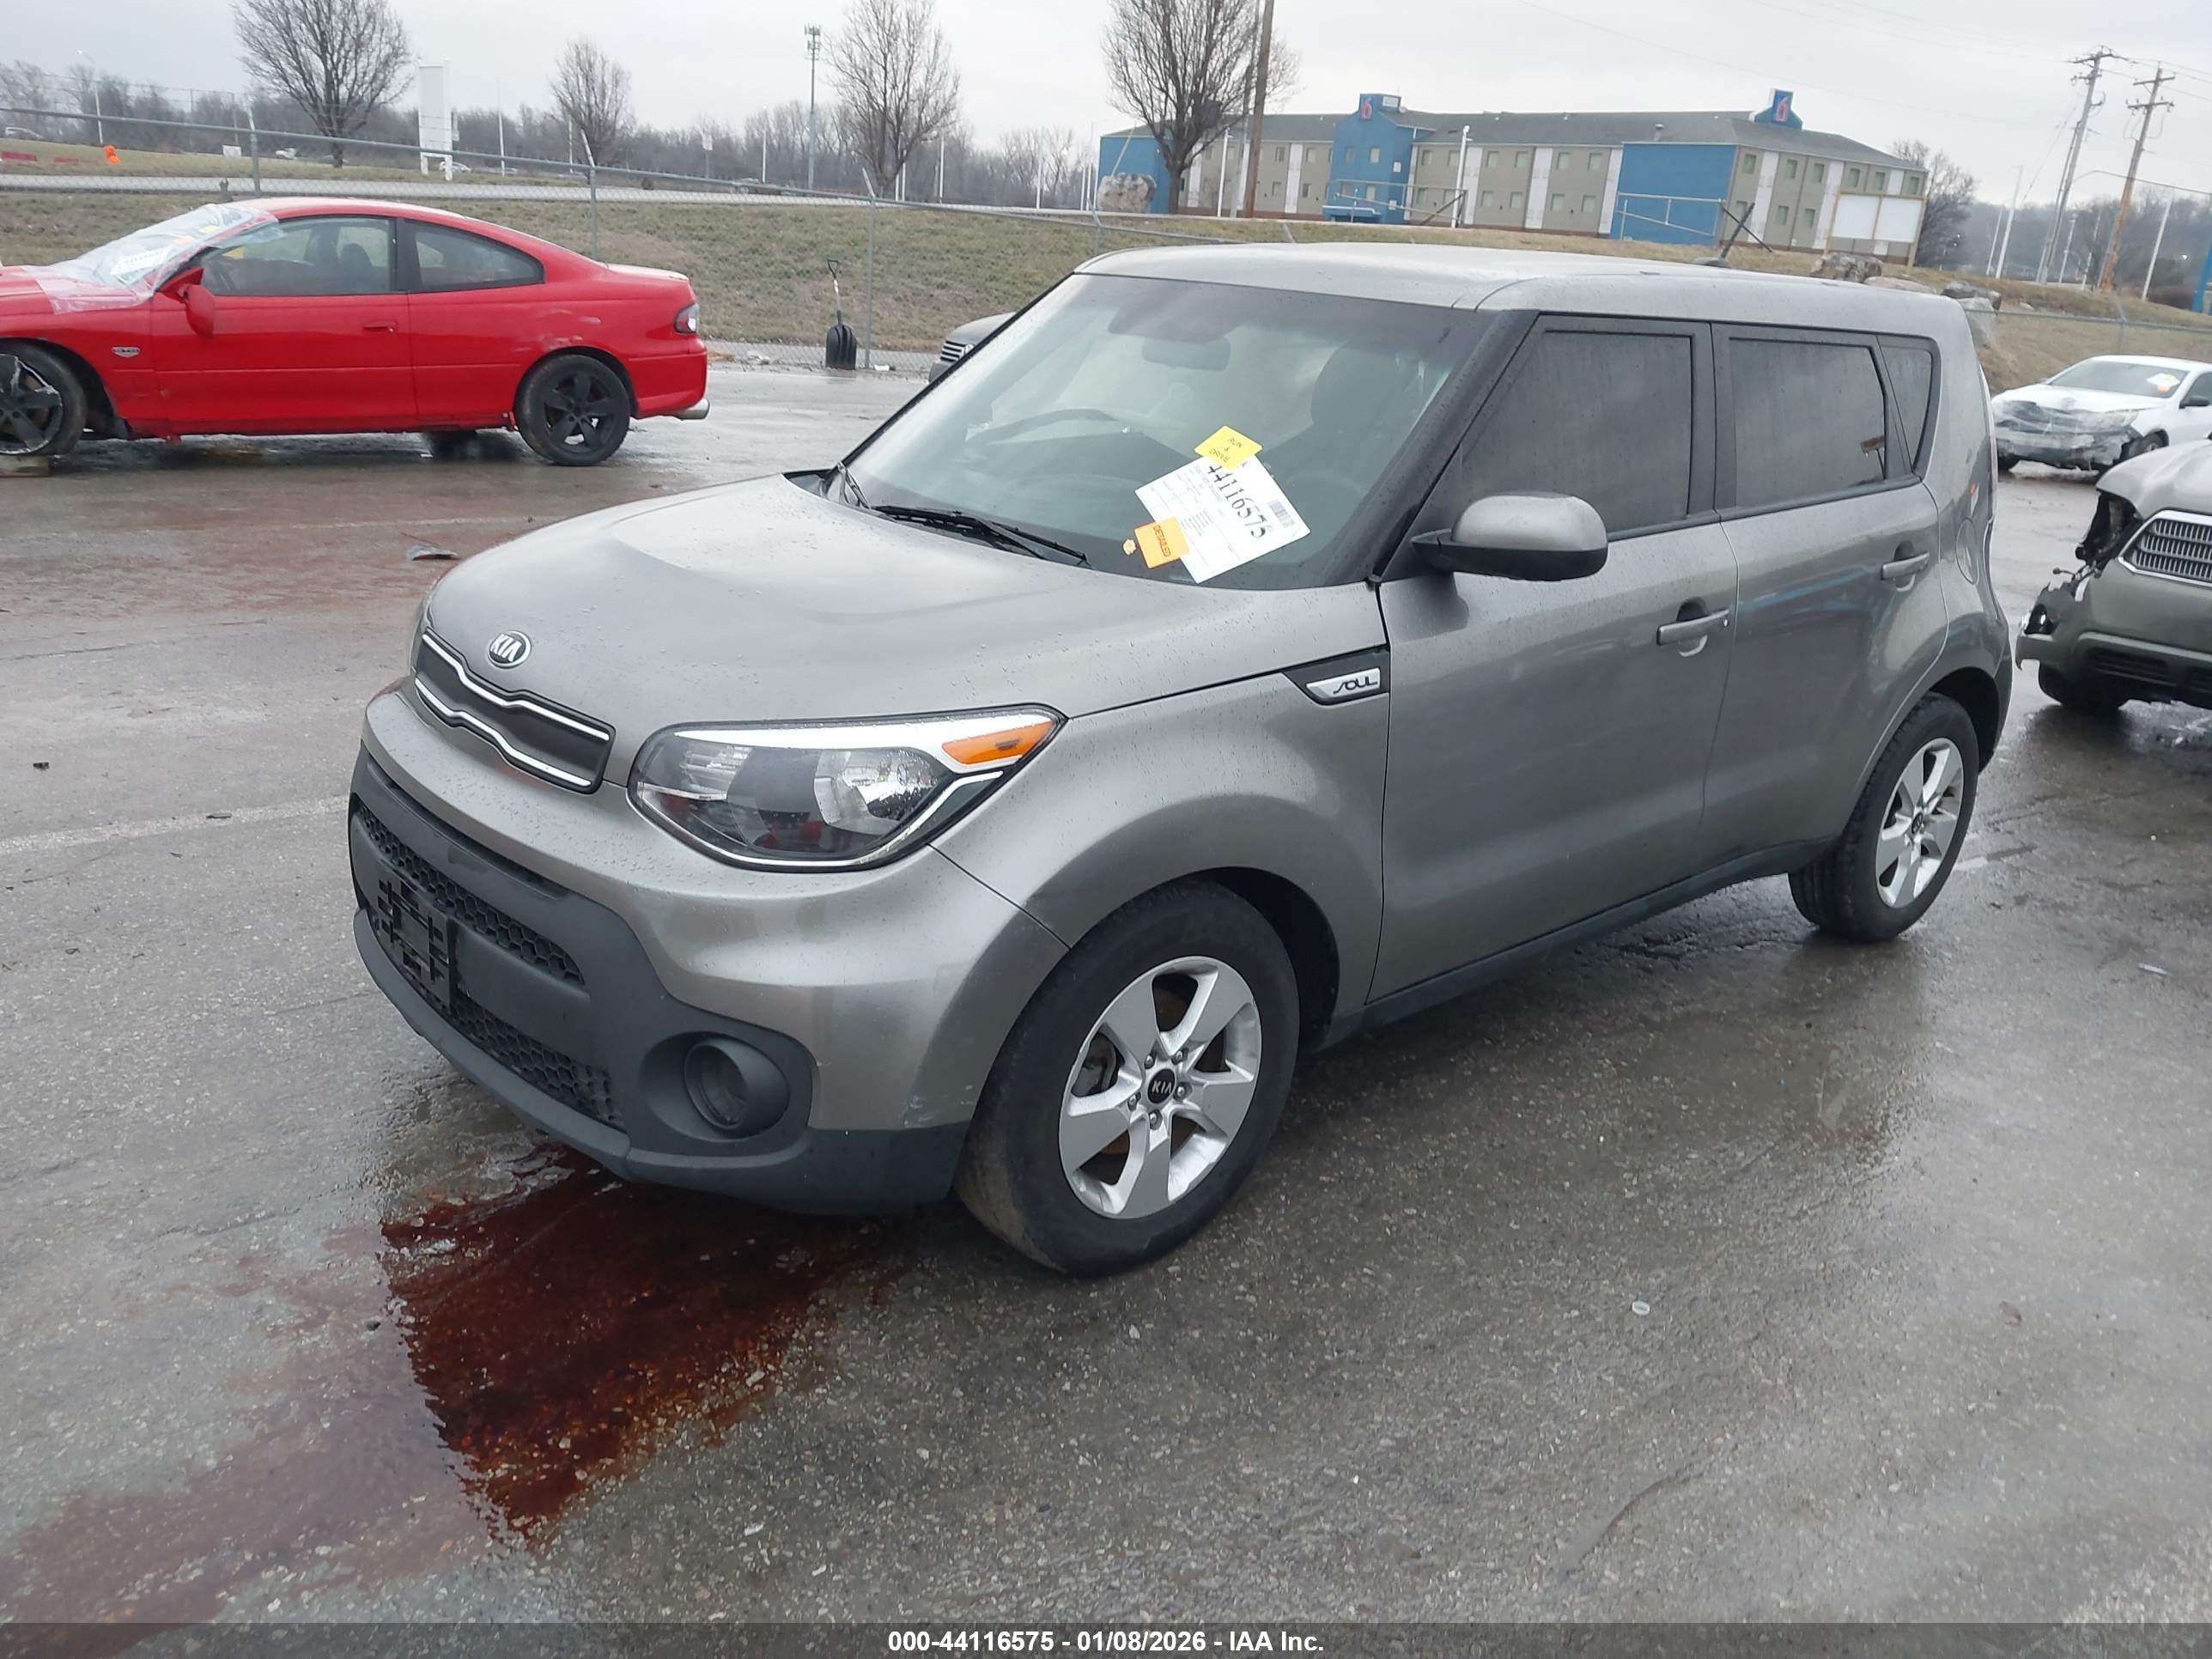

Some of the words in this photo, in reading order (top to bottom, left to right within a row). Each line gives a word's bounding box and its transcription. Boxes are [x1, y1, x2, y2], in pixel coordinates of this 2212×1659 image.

[1207, 465, 1273, 538] 44116575
[1333, 676, 1378, 695] SOUL
[1152, 1080, 1172, 1094] KIA
